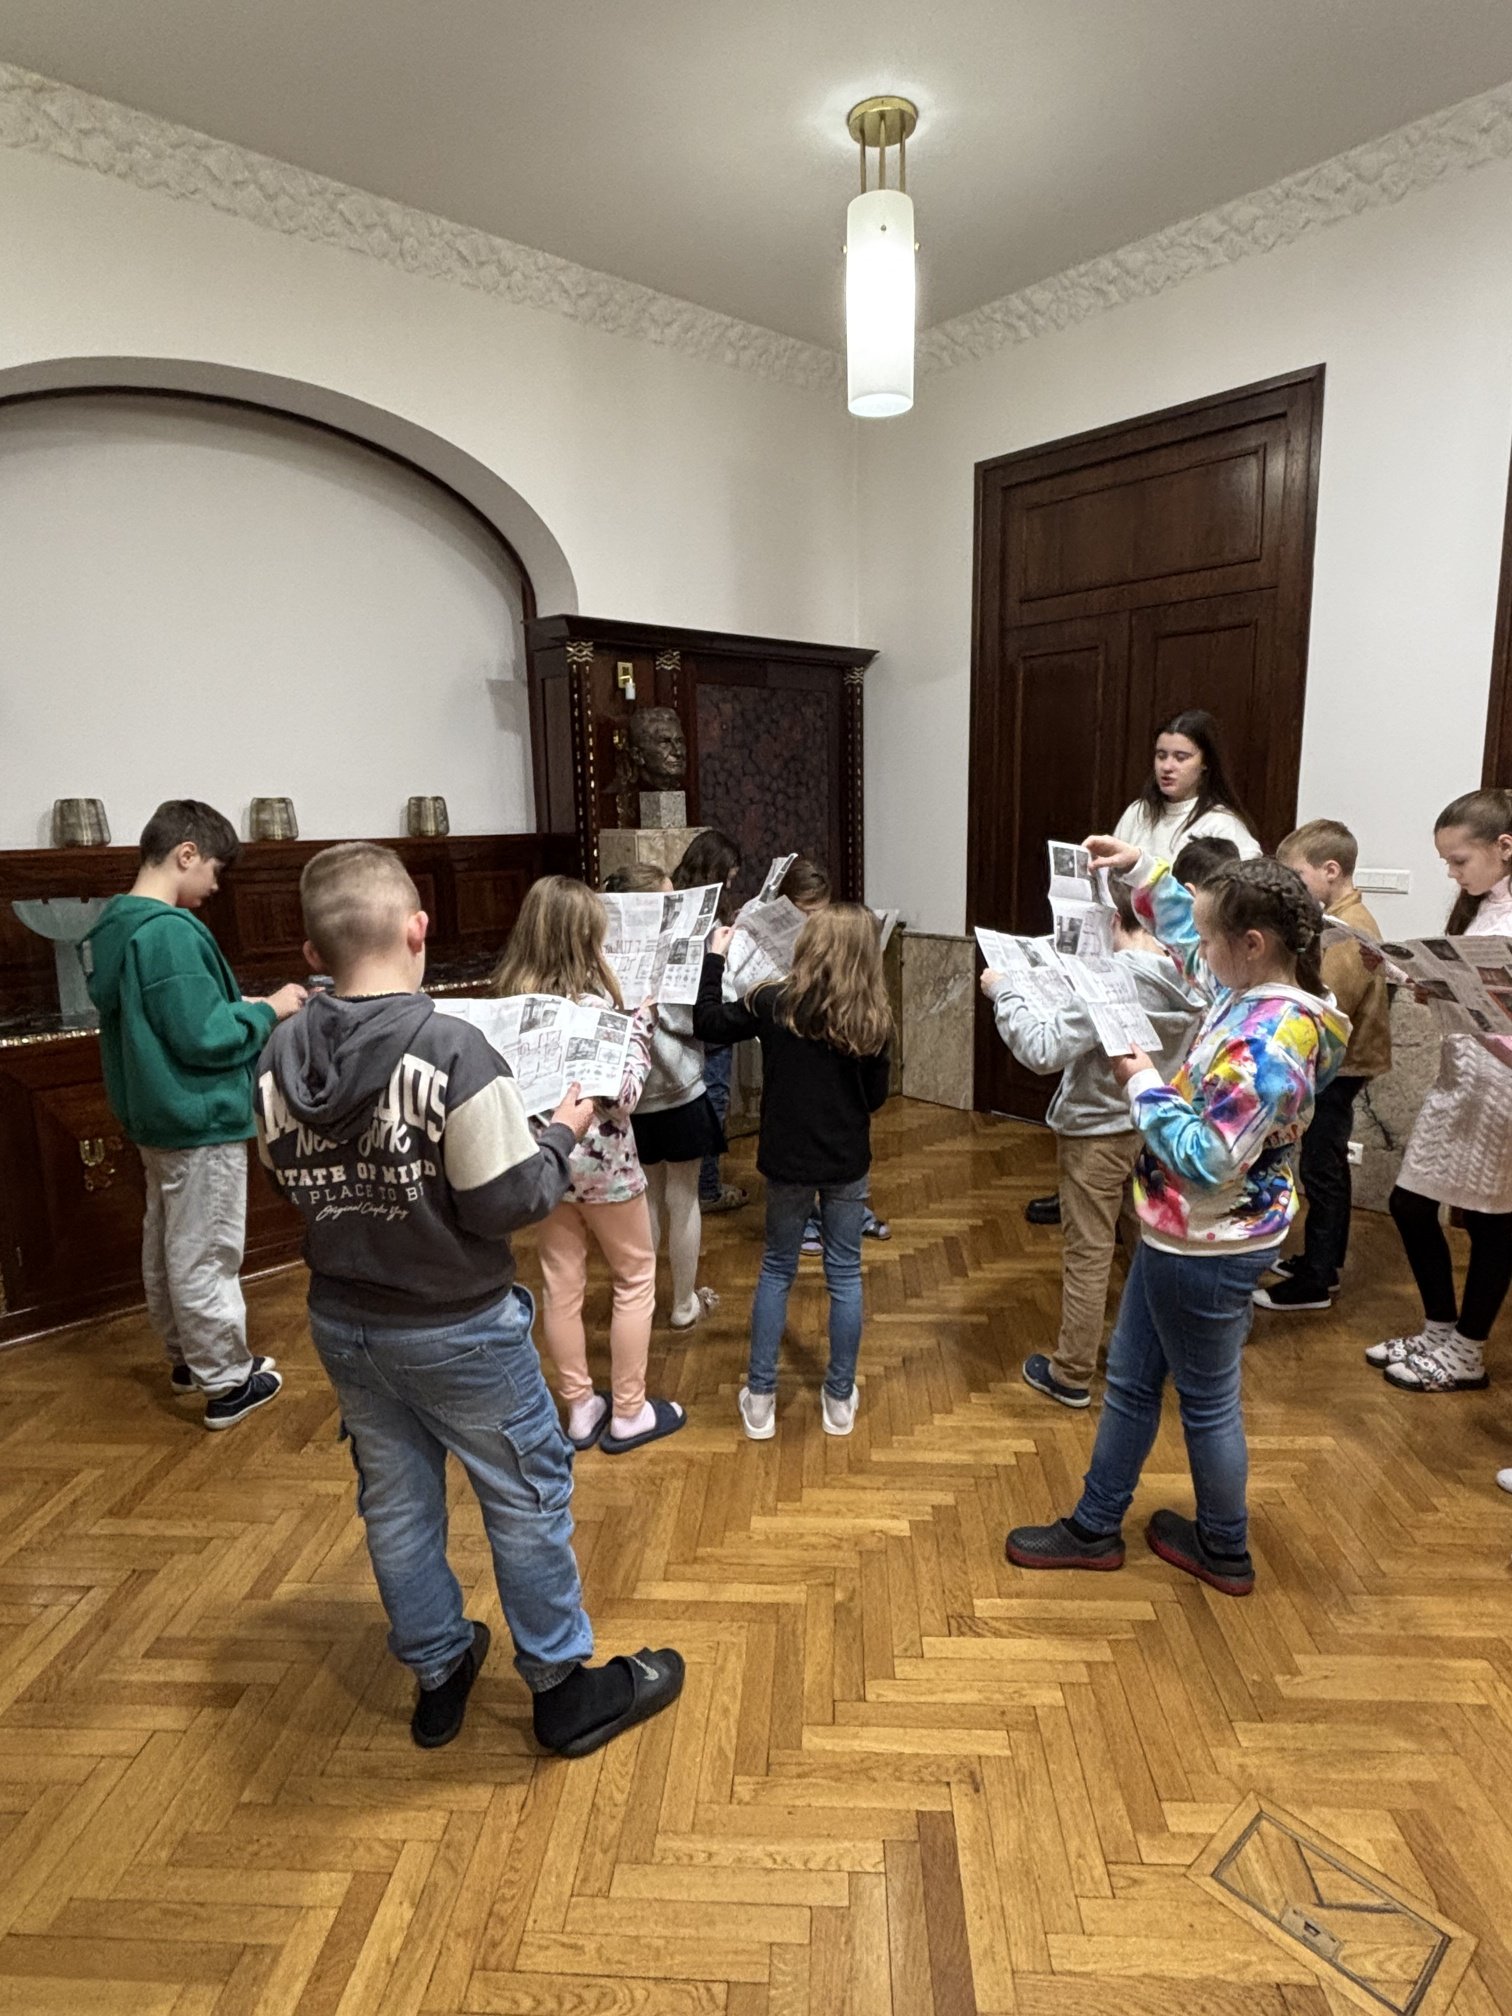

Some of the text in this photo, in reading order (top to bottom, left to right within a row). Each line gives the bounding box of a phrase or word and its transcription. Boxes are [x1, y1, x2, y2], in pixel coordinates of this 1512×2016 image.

[381, 1159, 437, 1185] MIND
[309, 1183, 374, 1205] PLACE
[378, 1185, 397, 1201] TO
